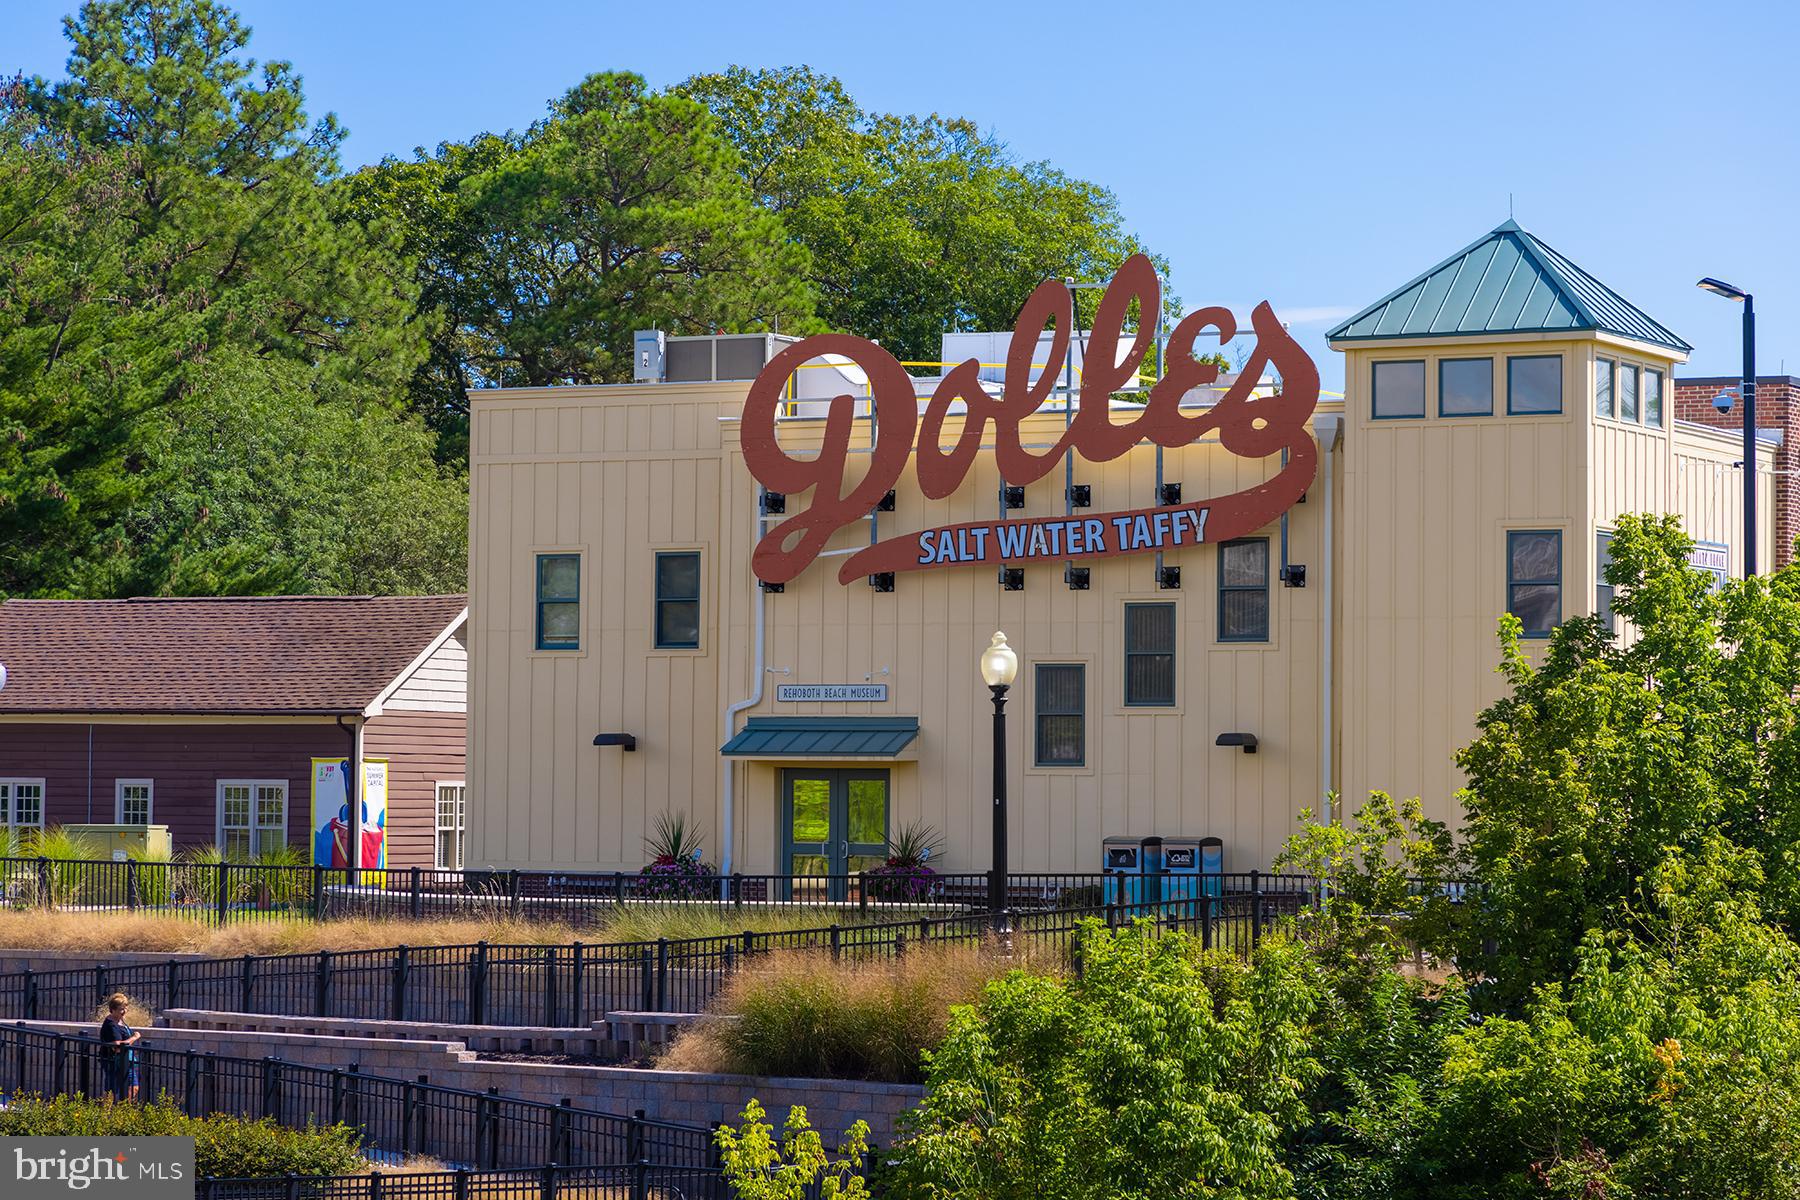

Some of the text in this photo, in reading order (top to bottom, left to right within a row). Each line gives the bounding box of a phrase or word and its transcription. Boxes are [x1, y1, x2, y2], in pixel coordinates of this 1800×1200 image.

[643, 358, 648, 367] 2
[741, 253, 1320, 584] Dolles
[918, 507, 1210, 564] SALT WATER TAFFY
[783, 688, 881, 698] REHOBOTH BEACH MUSEUM
